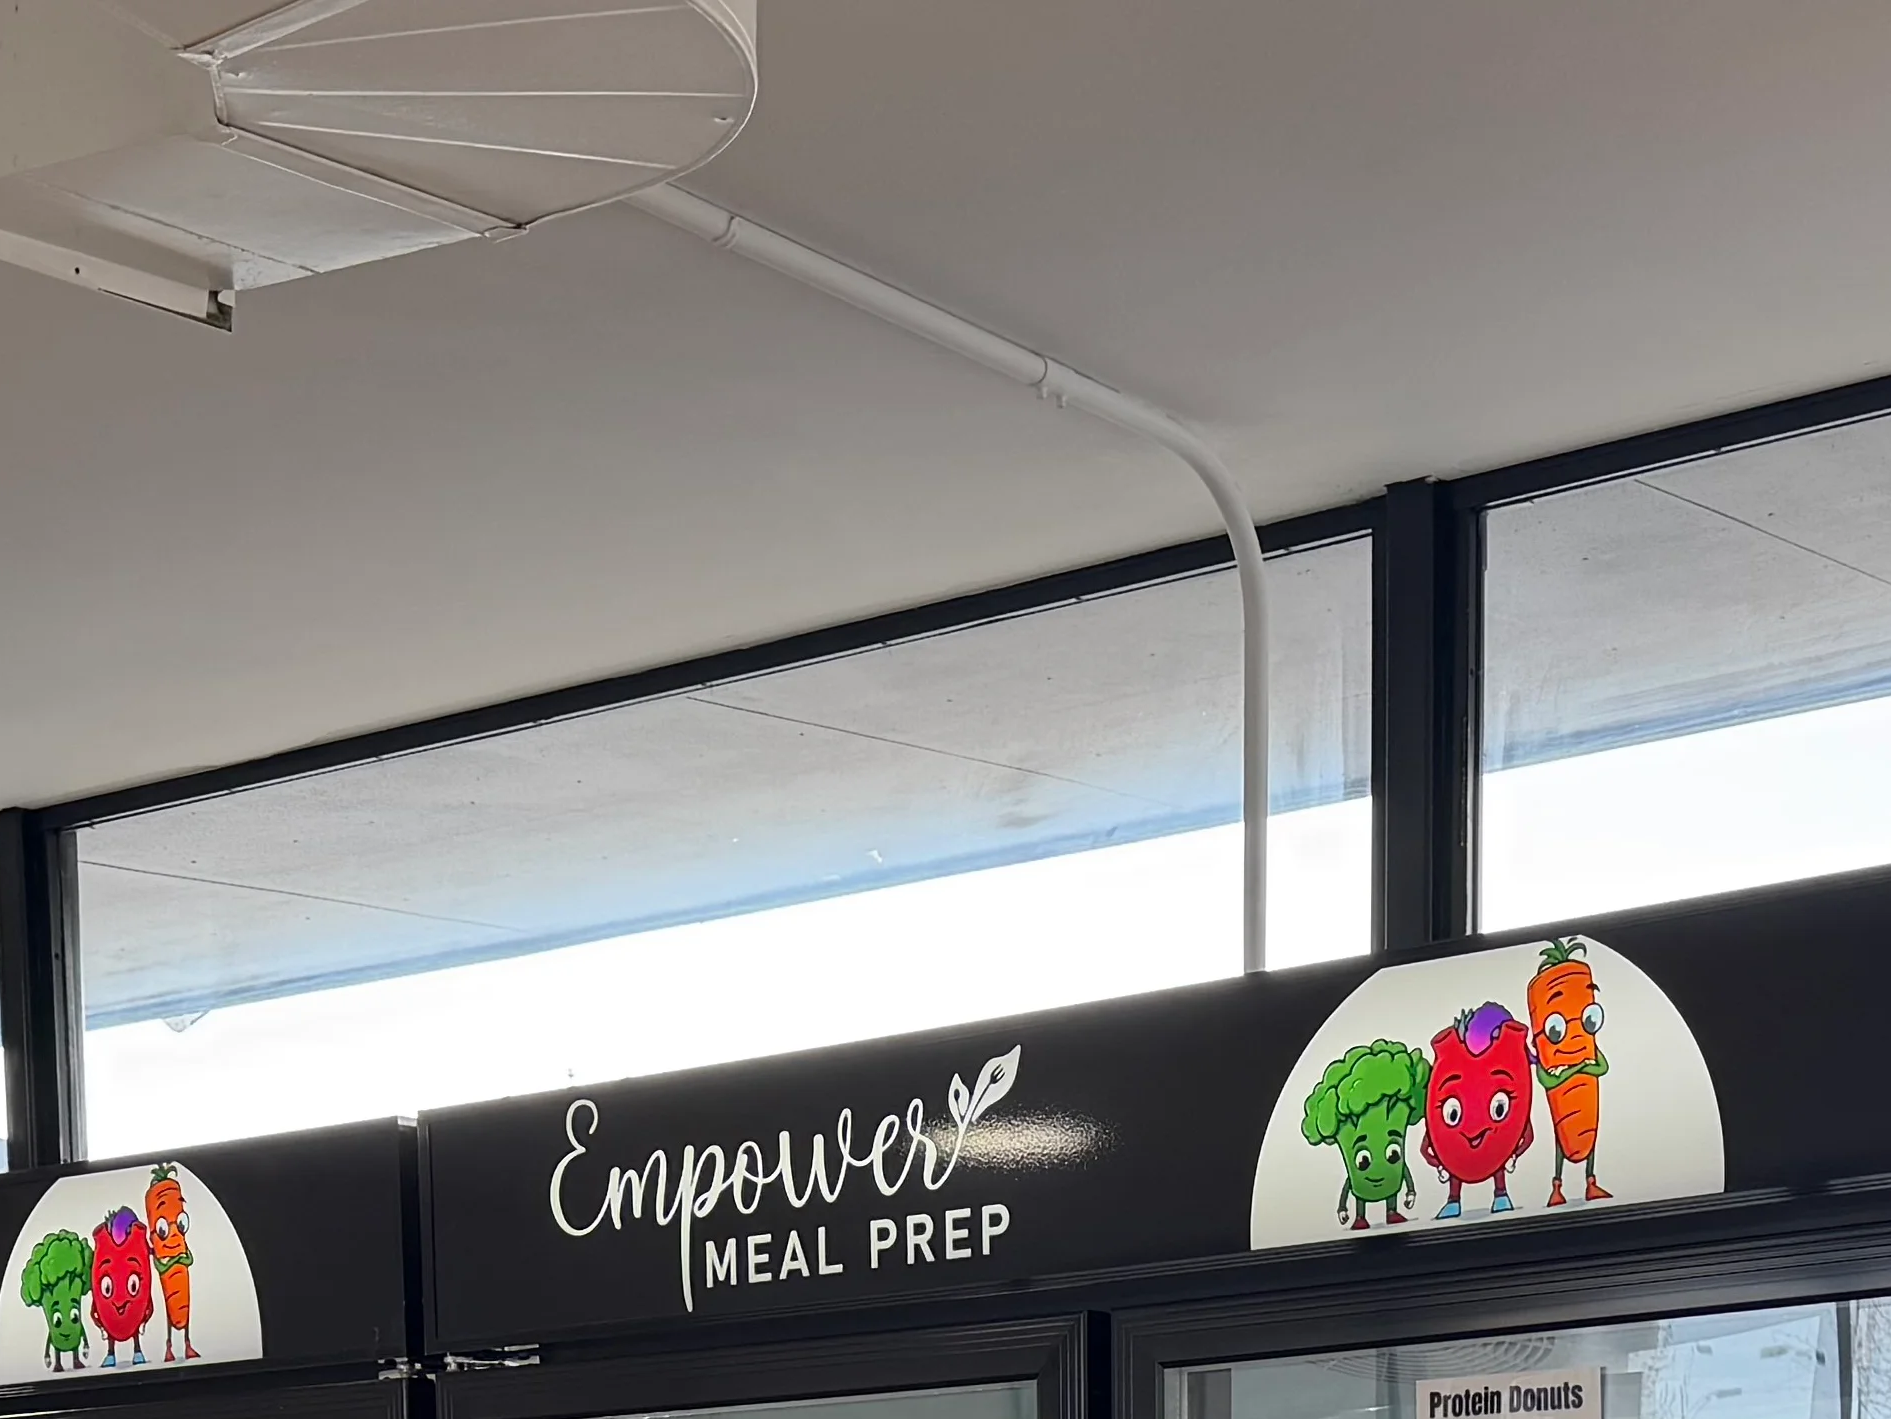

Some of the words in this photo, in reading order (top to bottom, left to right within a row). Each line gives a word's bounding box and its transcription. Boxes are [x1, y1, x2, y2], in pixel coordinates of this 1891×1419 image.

[550, 1098, 964, 1312] Empower
[706, 1226, 843, 1288] MEAL
[870, 1203, 1010, 1269] PREP
[1429, 1386, 1502, 1418] Protein
[1508, 1382, 1583, 1413] Donuts
